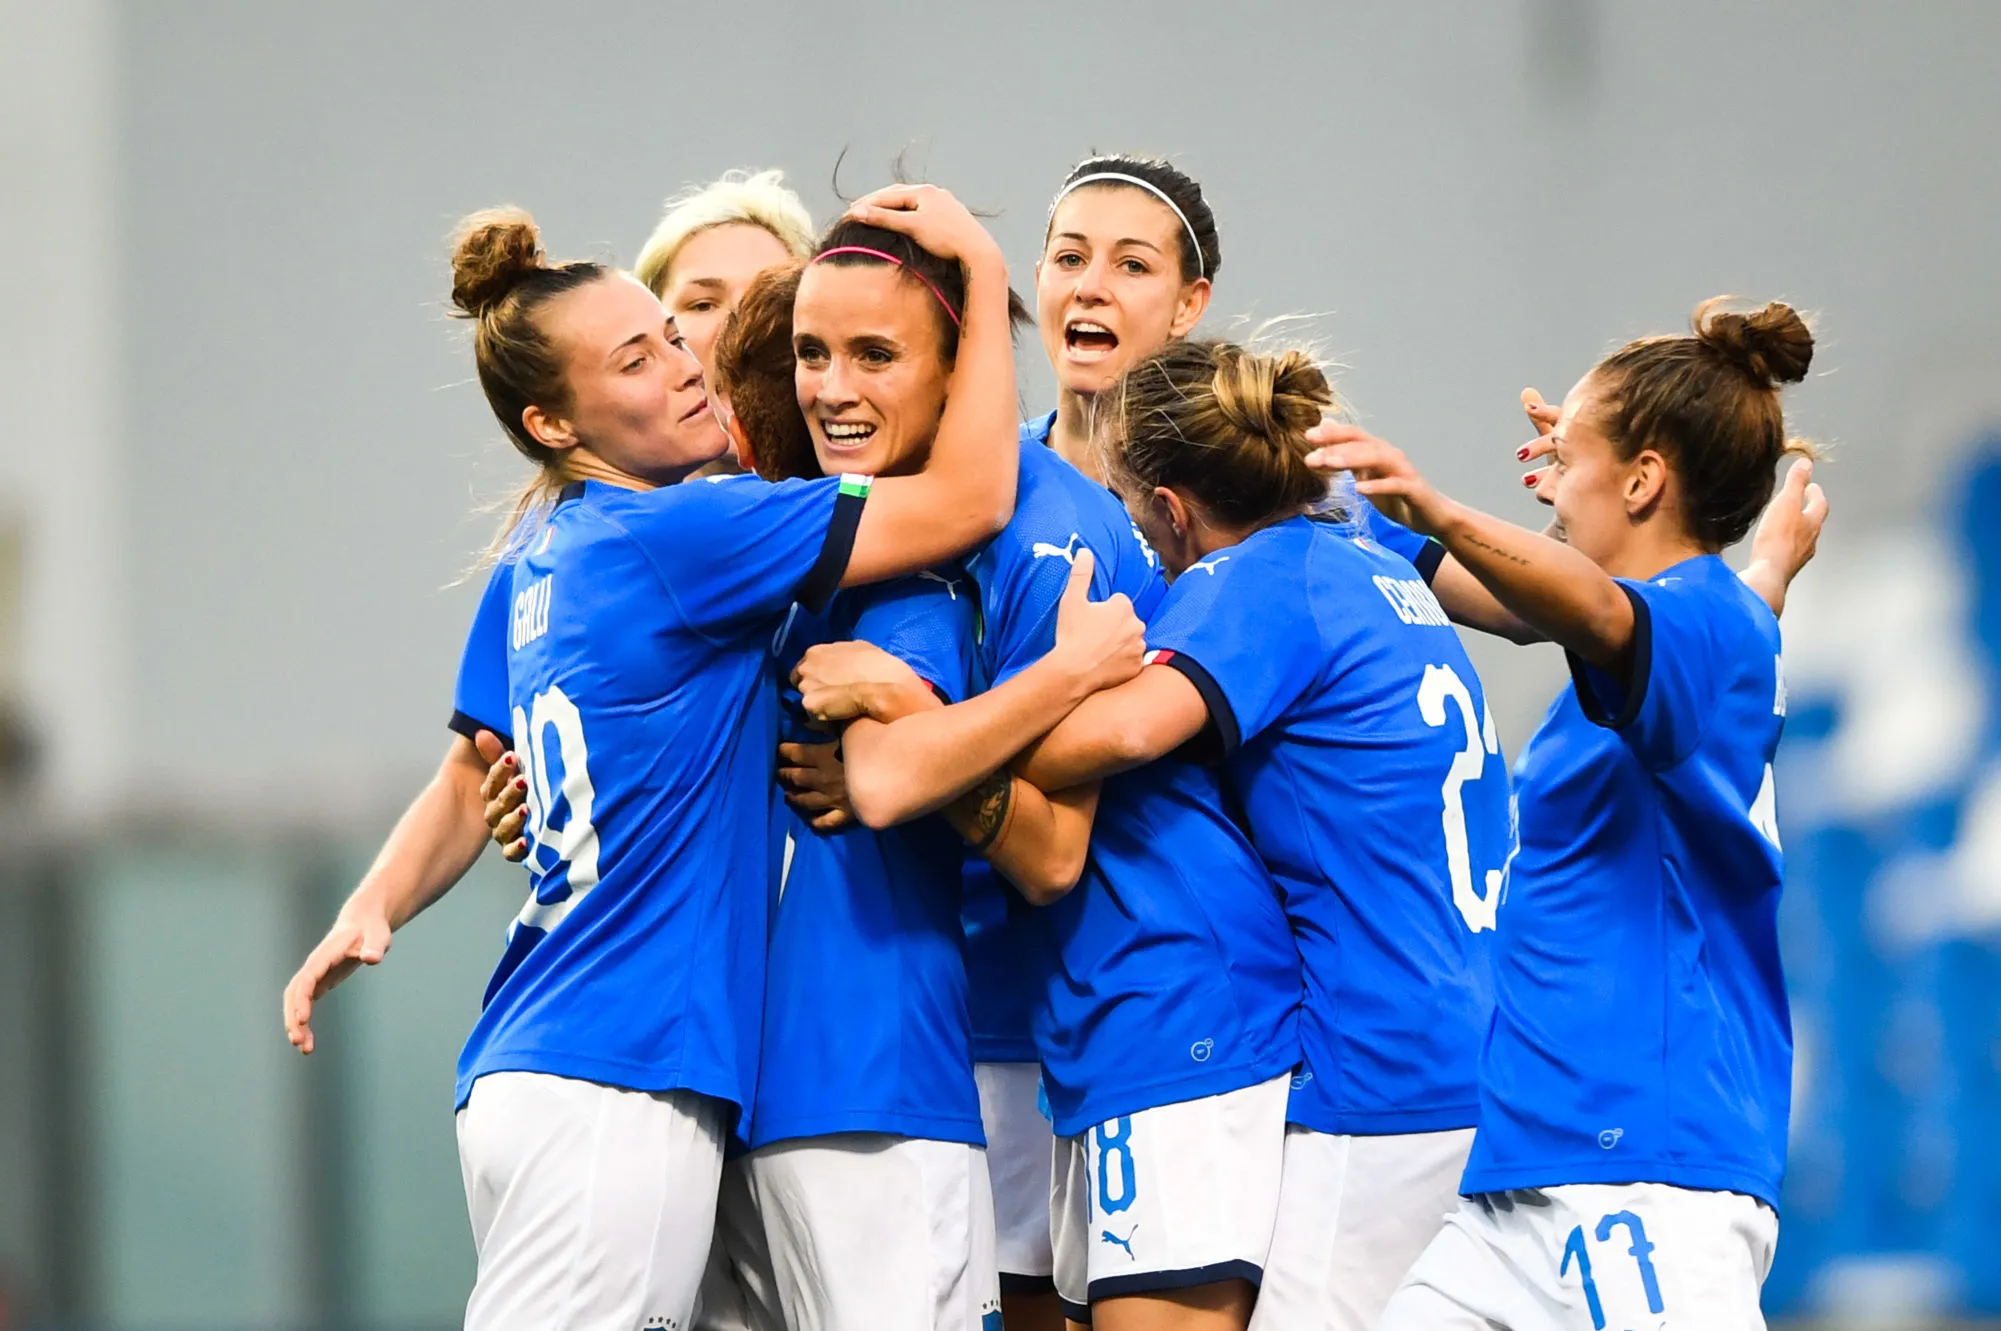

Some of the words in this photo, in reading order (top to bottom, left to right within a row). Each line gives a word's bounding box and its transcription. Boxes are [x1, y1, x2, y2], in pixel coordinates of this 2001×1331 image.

[513, 573, 553, 652] GALLI
[1417, 663, 1502, 933] 2
[1560, 1210, 1664, 1331] 17
